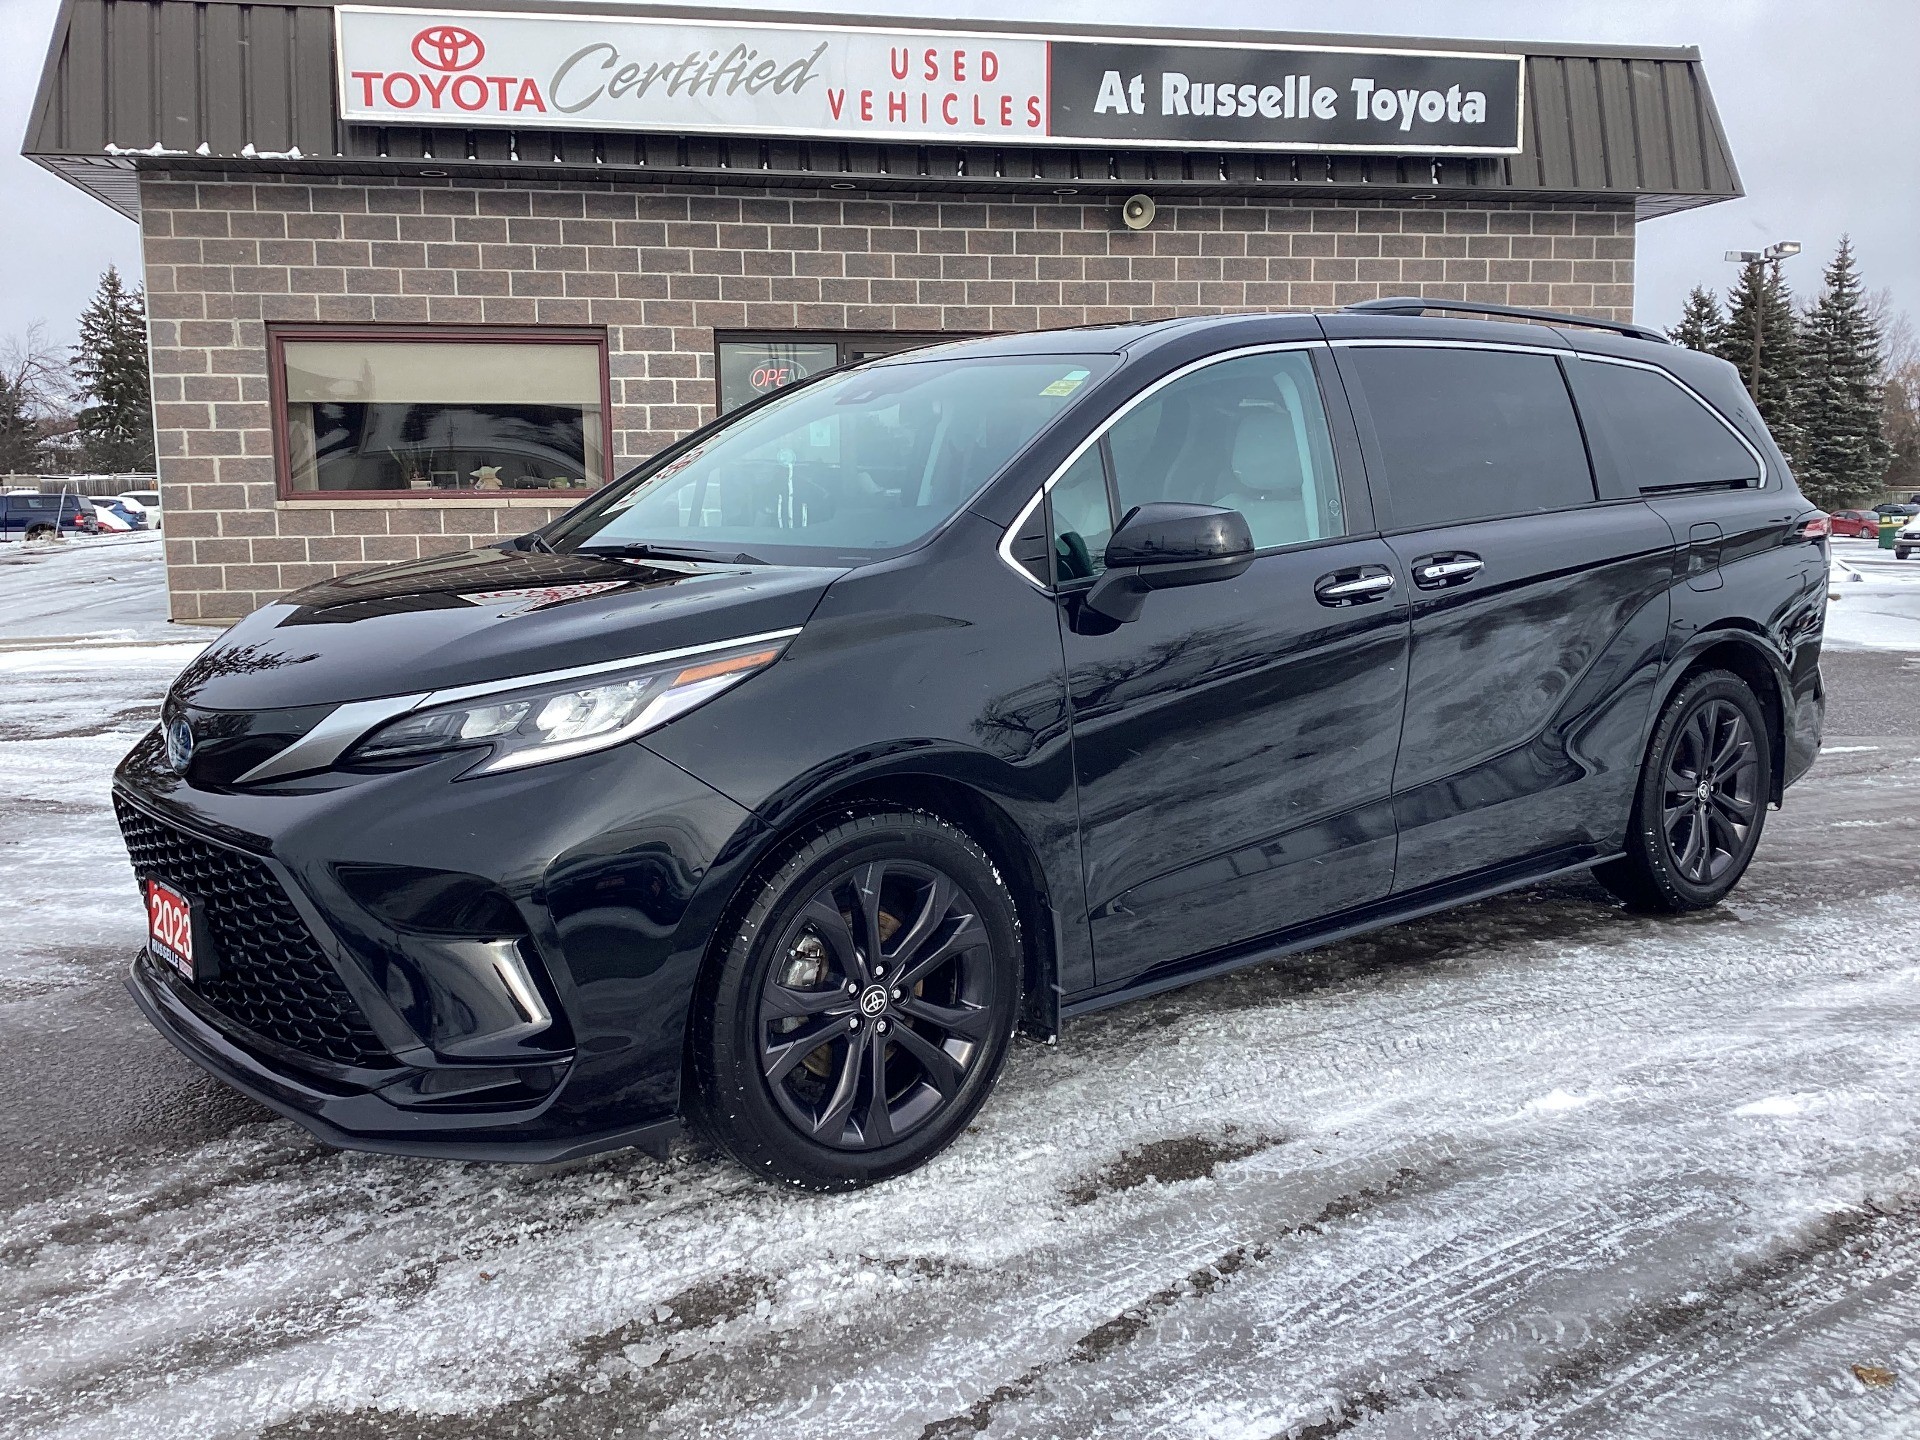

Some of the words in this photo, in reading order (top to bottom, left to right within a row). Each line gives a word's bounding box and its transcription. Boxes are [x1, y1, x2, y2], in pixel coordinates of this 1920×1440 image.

[351, 71, 547, 113] TOYOTA
[548, 40, 829, 114] Certified
[890, 46, 998, 81] USED
[827, 88, 1042, 128] VEHICLES
[1093, 70, 1146, 115] At
[1161, 72, 1338, 120] Russelle
[1350, 78, 1487, 132] Toyota
[152, 894, 192, 960] 2023
[152, 939, 179, 968] RUSSELLE
